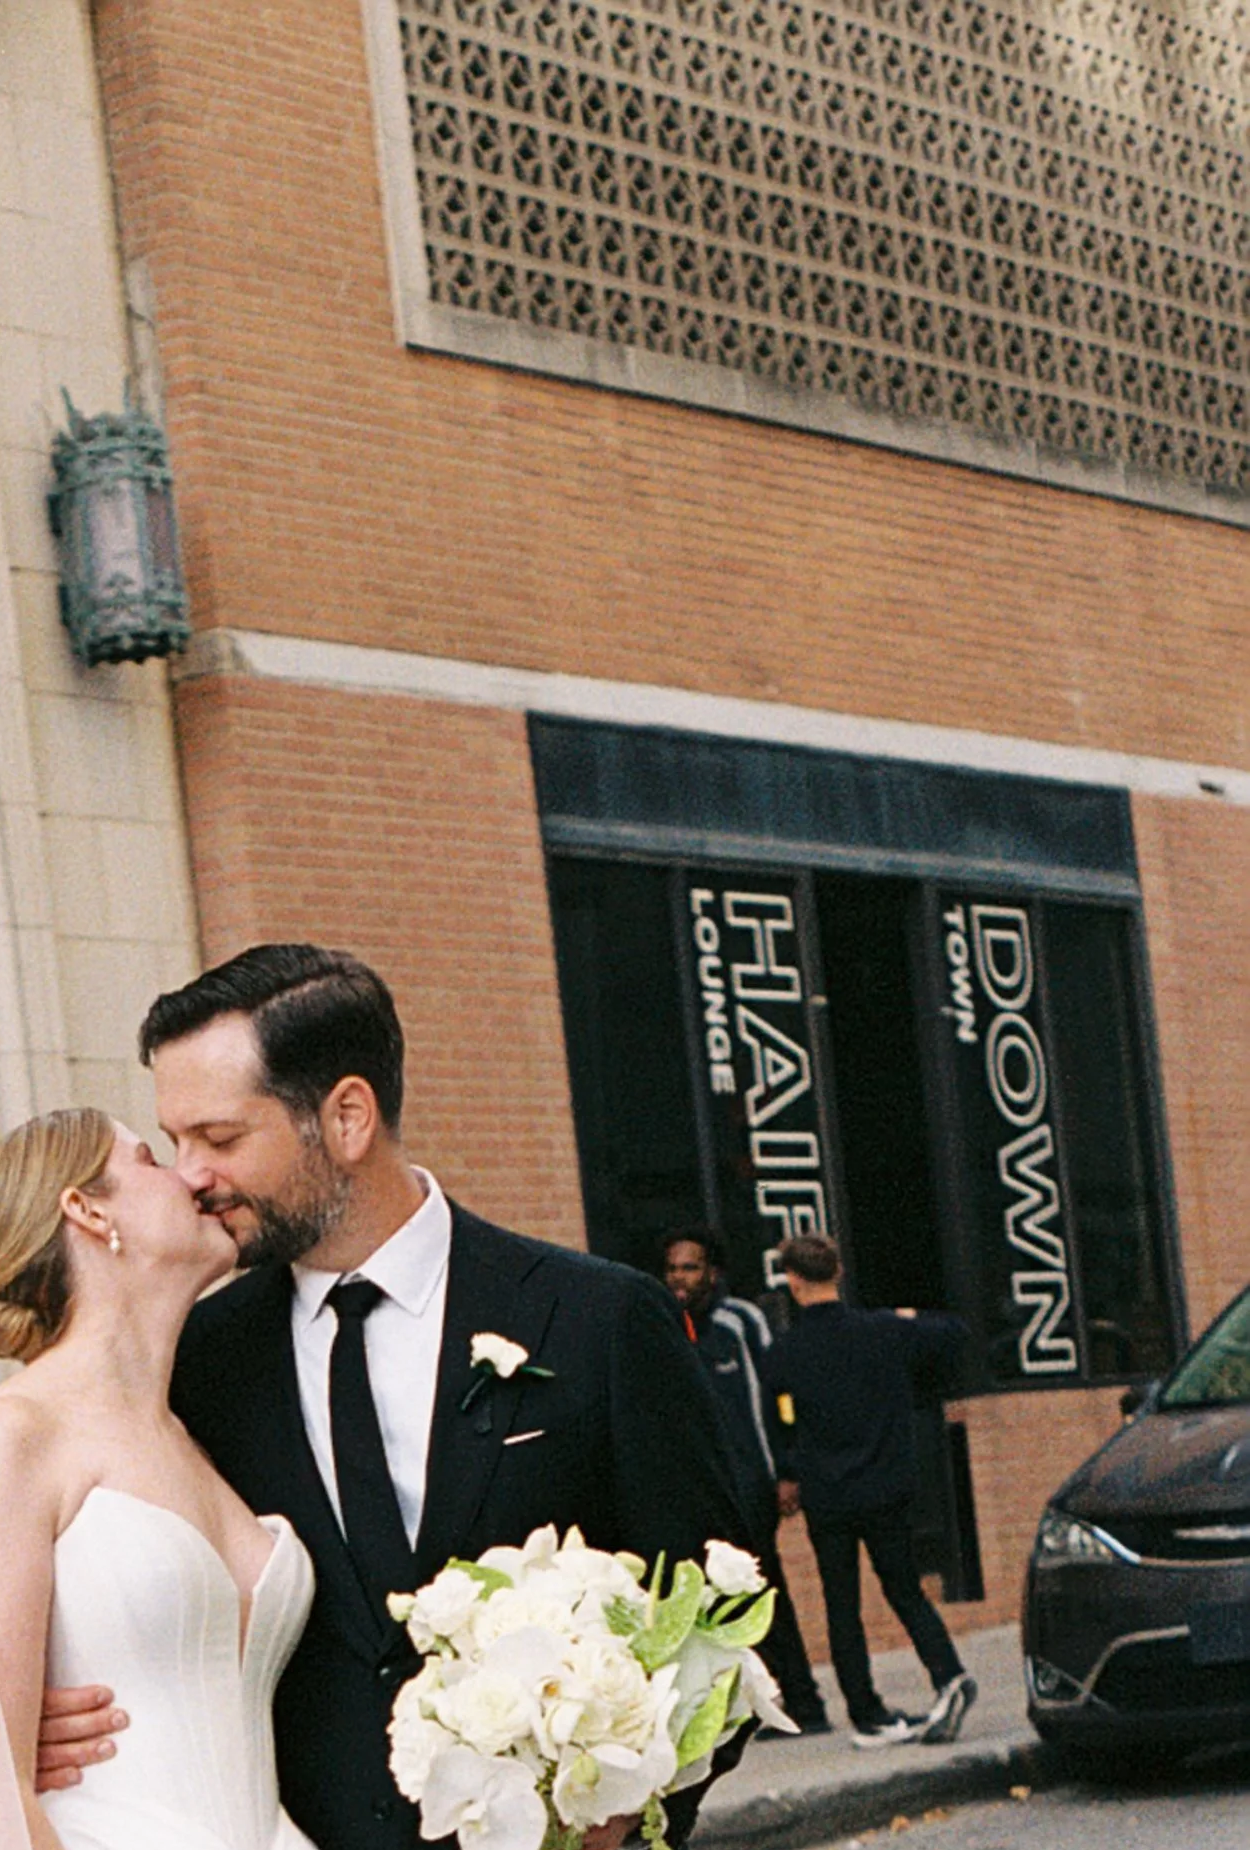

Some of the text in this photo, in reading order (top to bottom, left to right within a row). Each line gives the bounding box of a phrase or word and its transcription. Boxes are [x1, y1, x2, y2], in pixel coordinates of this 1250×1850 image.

[690, 887, 736, 1094] LOUNGE
[943, 903, 978, 1043] TOWN
[970, 904, 1077, 1374] DOWN
